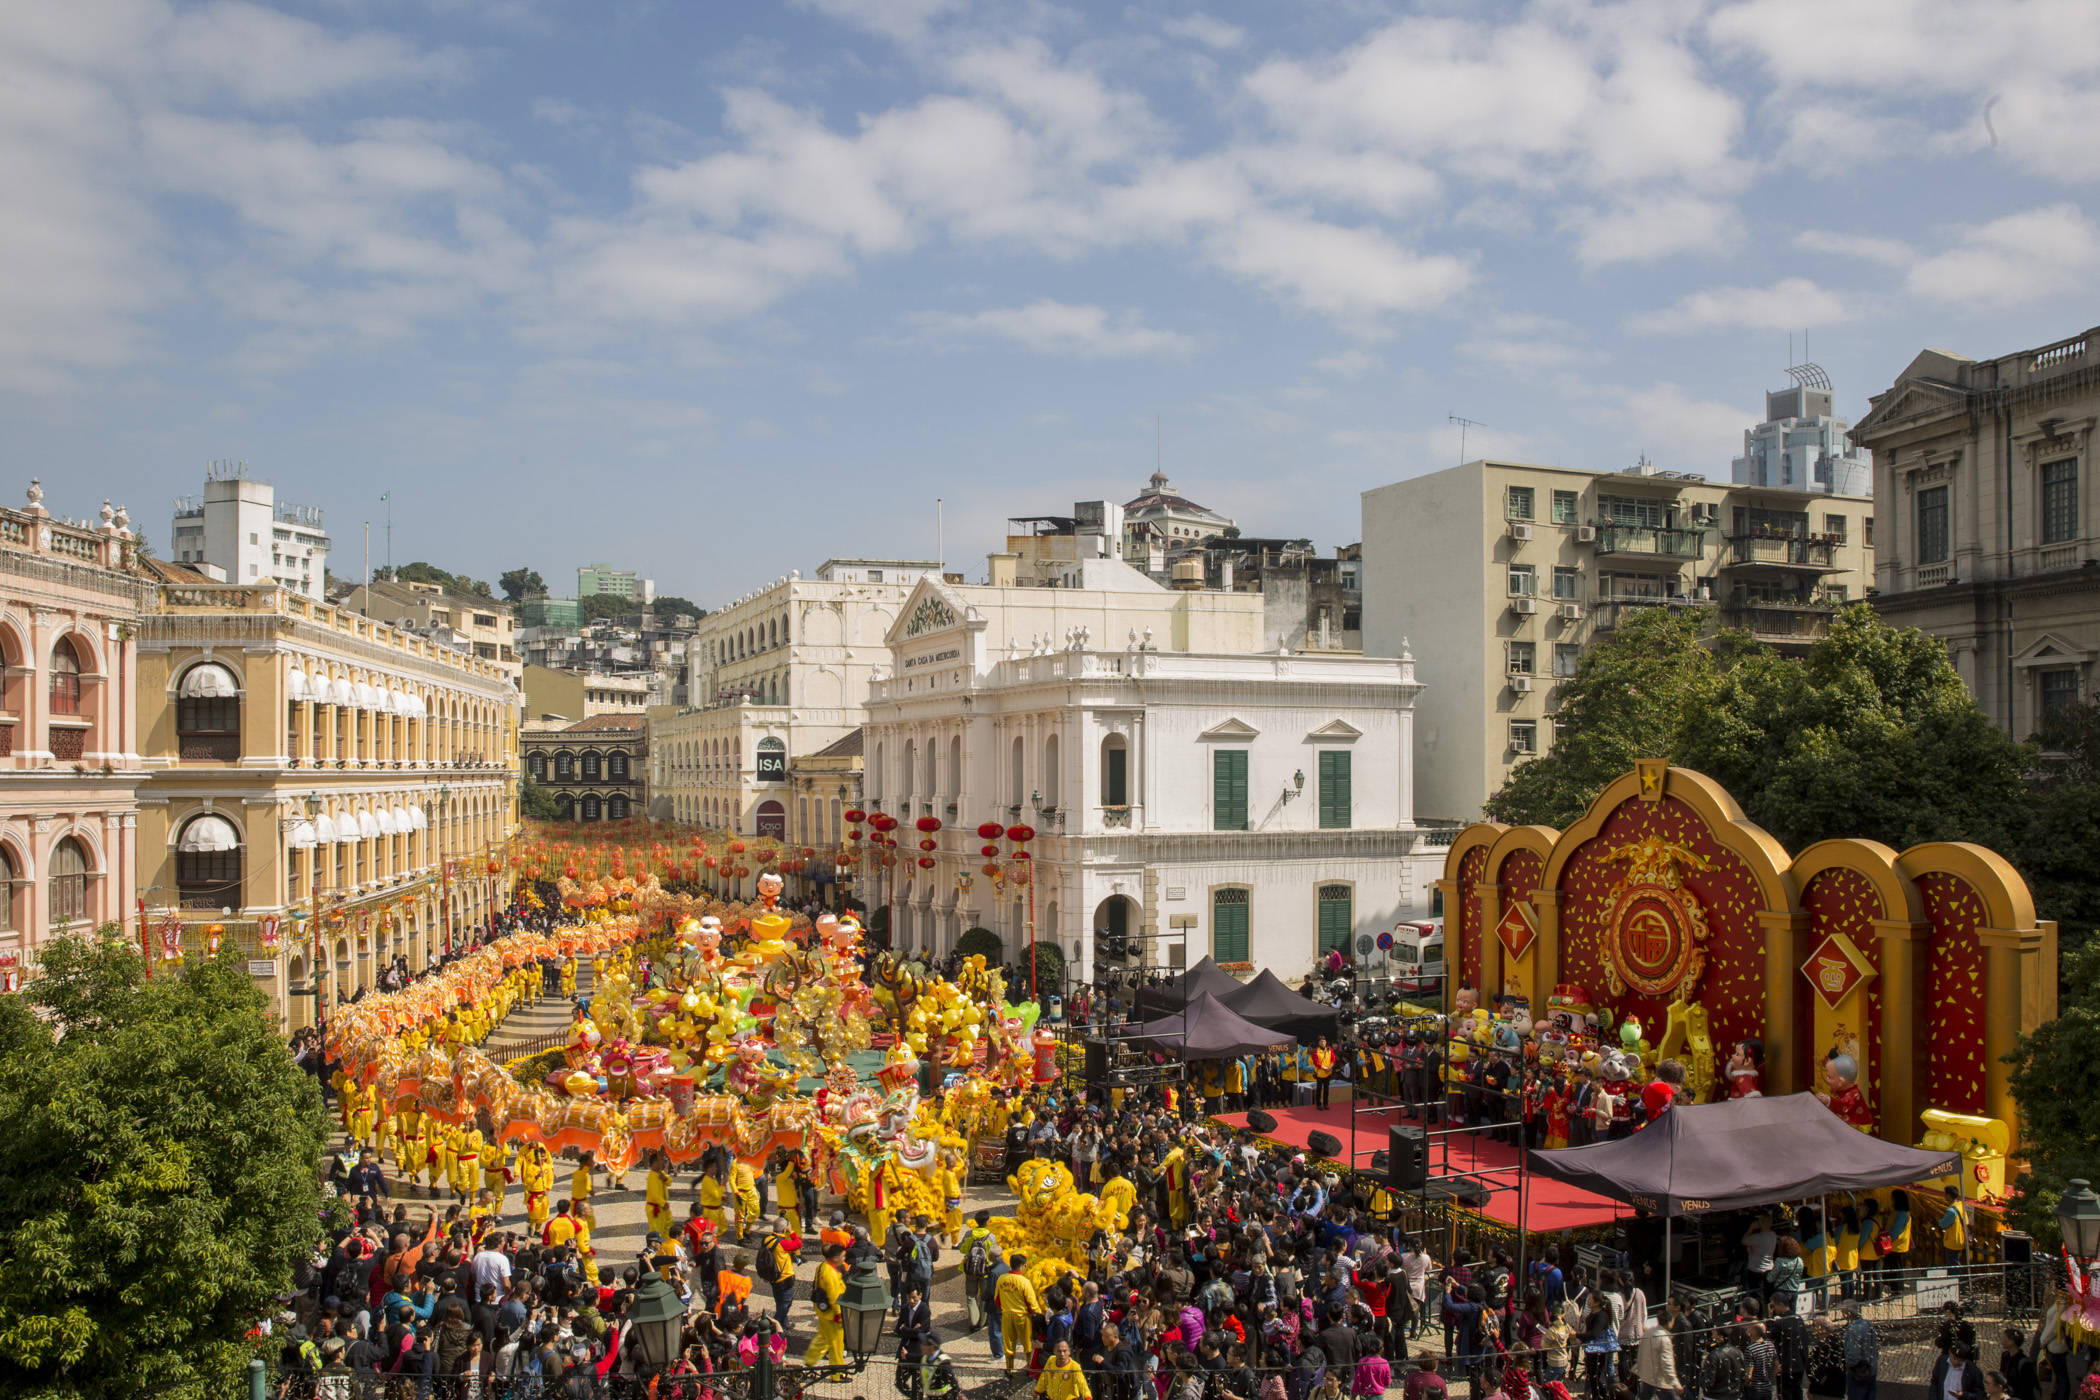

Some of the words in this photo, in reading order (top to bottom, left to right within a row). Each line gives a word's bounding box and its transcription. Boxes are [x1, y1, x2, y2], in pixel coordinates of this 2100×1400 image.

[905, 658, 917, 668] SANTA
[918, 655, 928, 666] CASA
[929, 653, 935, 663] DA
[759, 759, 783, 771] ISA
[1269, 1043, 1289, 1052] VENUS
[1631, 1194, 1657, 1210] VENUS
[1681, 1199, 1711, 1211] VENUS
